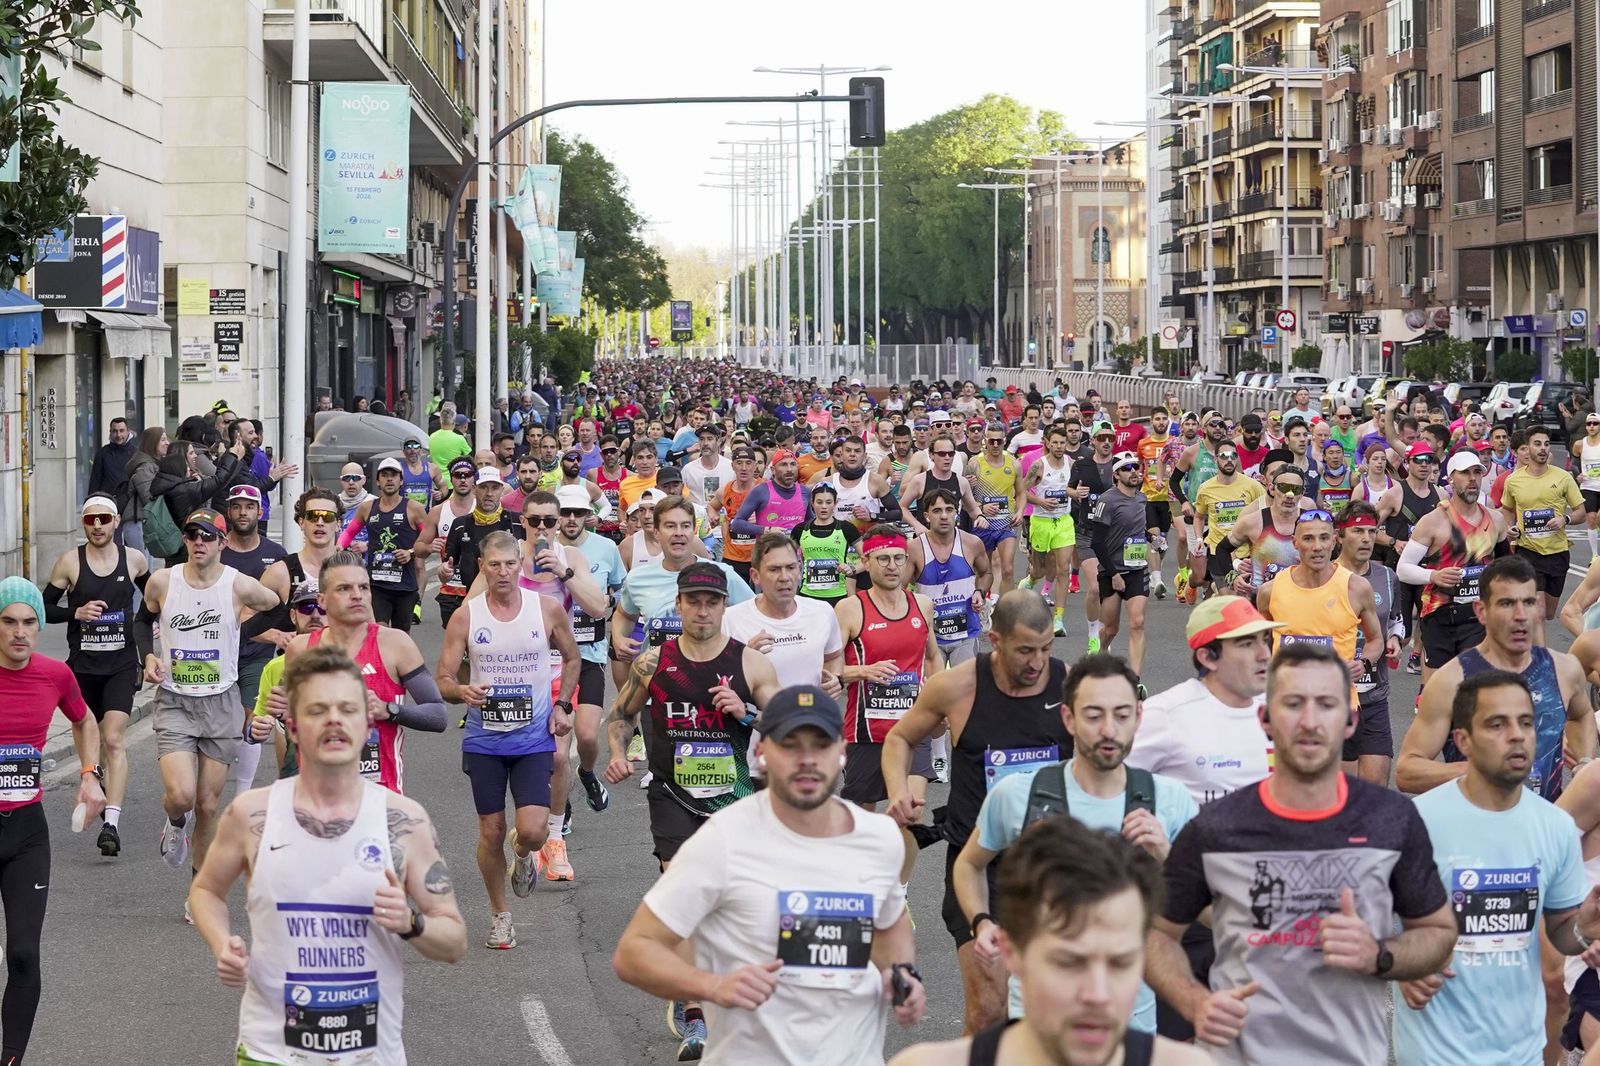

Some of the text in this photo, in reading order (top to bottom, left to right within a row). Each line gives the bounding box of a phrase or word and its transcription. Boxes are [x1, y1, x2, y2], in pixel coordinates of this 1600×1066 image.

[340, 152, 375, 160] ZURICH
[338, 171, 375, 179] SEVILLA
[48, 388, 57, 450] BARBERIA
[809, 575, 836, 583] ALESSIA
[941, 608, 963, 616] ZURICH
[170, 609, 222, 629] Bike Time
[938, 625, 958, 635] KUKO
[81, 632, 126, 643] JUAN MARÍA
[1297, 636, 1327, 646] ZURICH
[498, 652, 539, 663] CALIFATO
[187, 664, 203, 672] 2260
[480, 664, 538, 674] INDEPENDIENTE
[171, 673, 205, 683] CARLOS
[493, 676, 524, 685] SEVILLA
[496, 687, 527, 695] ZURICH
[885, 688, 900, 696] 5141
[497, 701, 515, 709] 3924
[870, 697, 914, 708] STEFANO
[482, 710, 532, 721] DEL VALLE
[0, 747, 35, 756] ZURICH
[696, 746, 728, 754] ZURICH
[1010, 750, 1051, 762] ZURICH
[697, 763, 716, 771] 2564
[1213, 760, 1241, 769] renting
[677, 773, 736, 786] THORZEUS
[1270, 856, 1361, 891] XXIX
[1484, 872, 1532, 886] ZURICH
[814, 896, 865, 912] ZURICH
[1484, 897, 1511, 910] 3739
[286, 917, 370, 939] WYE VALLEY
[1465, 913, 1528, 934] NASSIM
[814, 925, 842, 940] 4431
[1247, 931, 1322, 948] CAMPUZ
[298, 947, 366, 968] RUNNERS
[807, 944, 848, 966] TOM
[317, 986, 369, 1003] ZURICH
[317, 1015, 348, 1029] 4880
[301, 1030, 363, 1052] OLIVER
